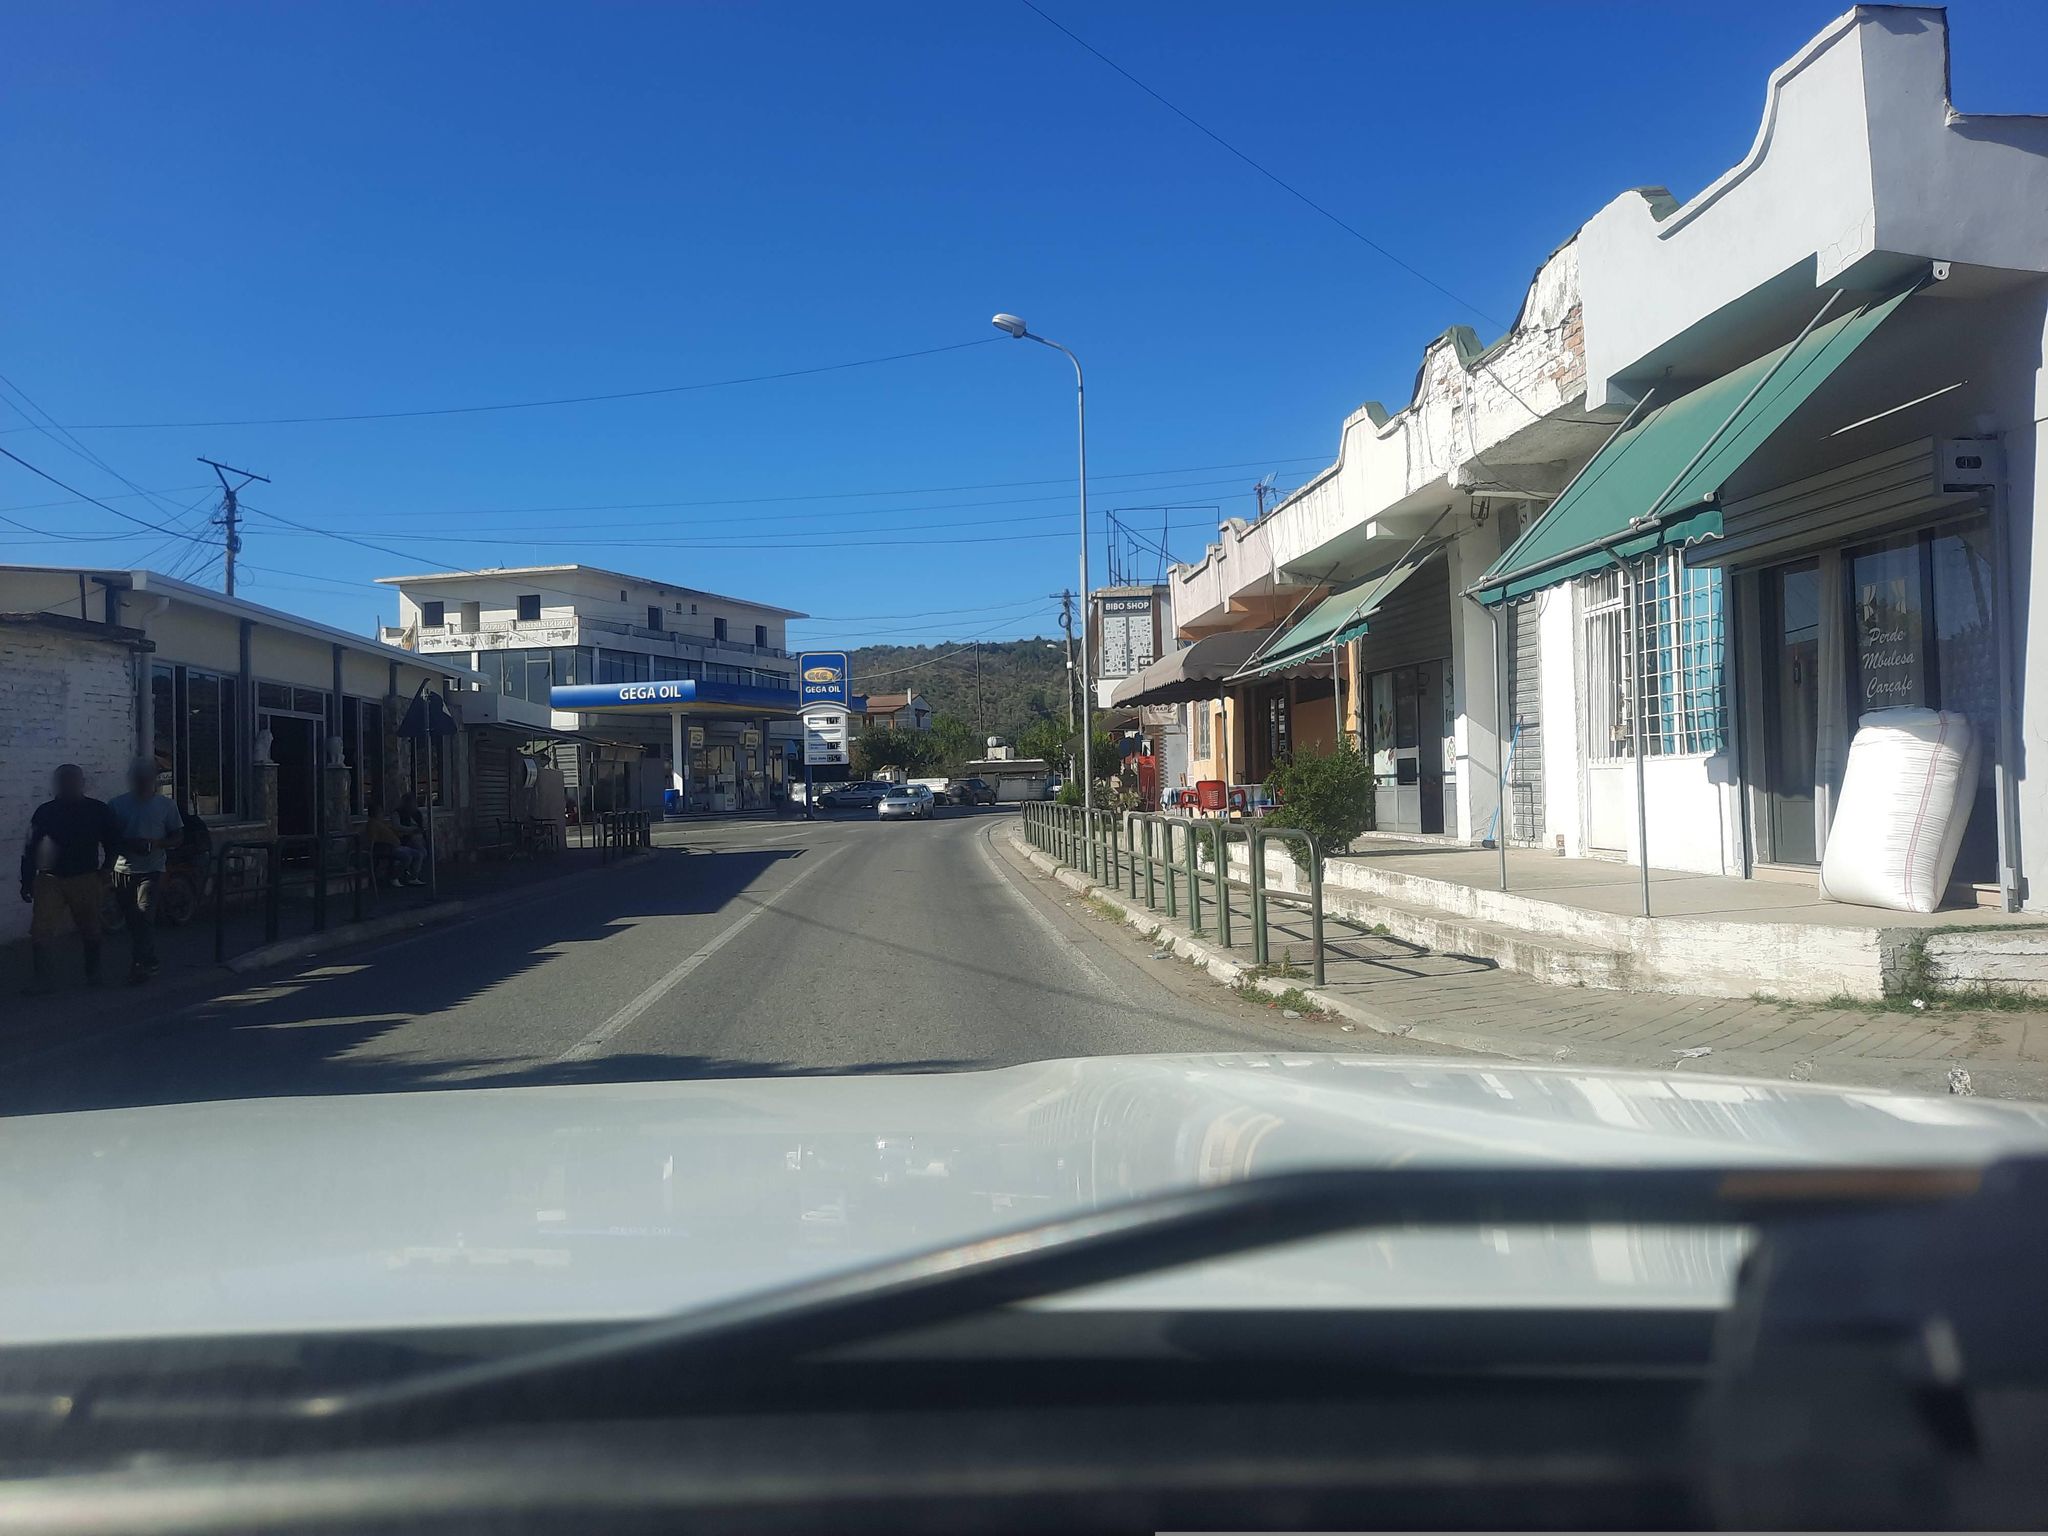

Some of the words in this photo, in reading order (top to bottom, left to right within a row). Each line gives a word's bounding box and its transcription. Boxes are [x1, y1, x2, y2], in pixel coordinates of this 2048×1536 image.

[1105, 603, 1125, 611] BIBO
[1126, 602, 1149, 610] SHOP
[1868, 626, 1904, 646] Perde
[1862, 650, 1915, 670] Mbulesa
[619, 687, 656, 700] GEGA
[659, 685, 682, 698] OIL
[828, 685, 841, 693] OIL
[1866, 674, 1913, 702] Çarçafe
